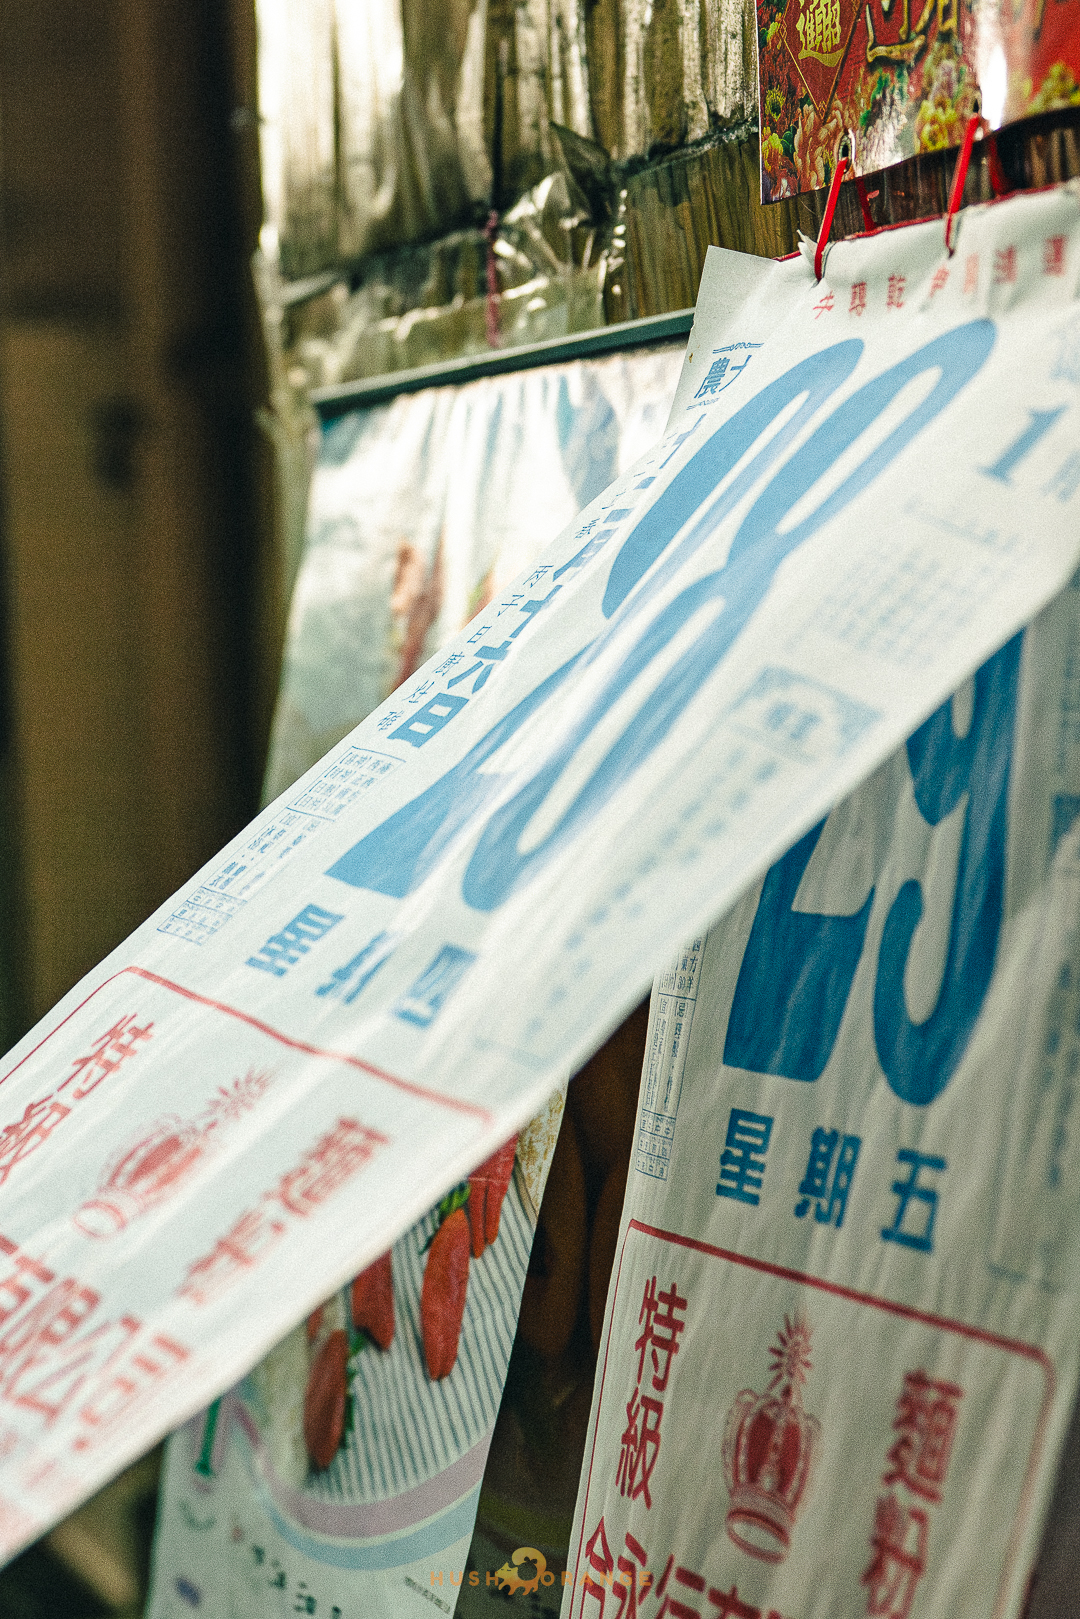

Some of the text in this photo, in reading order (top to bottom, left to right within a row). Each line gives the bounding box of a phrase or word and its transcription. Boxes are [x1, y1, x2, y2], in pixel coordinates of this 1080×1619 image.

[325, 317, 996, 912] 28
[716, 1107, 946, 1254] 星期五
[615, 1275, 688, 1510] 特級
